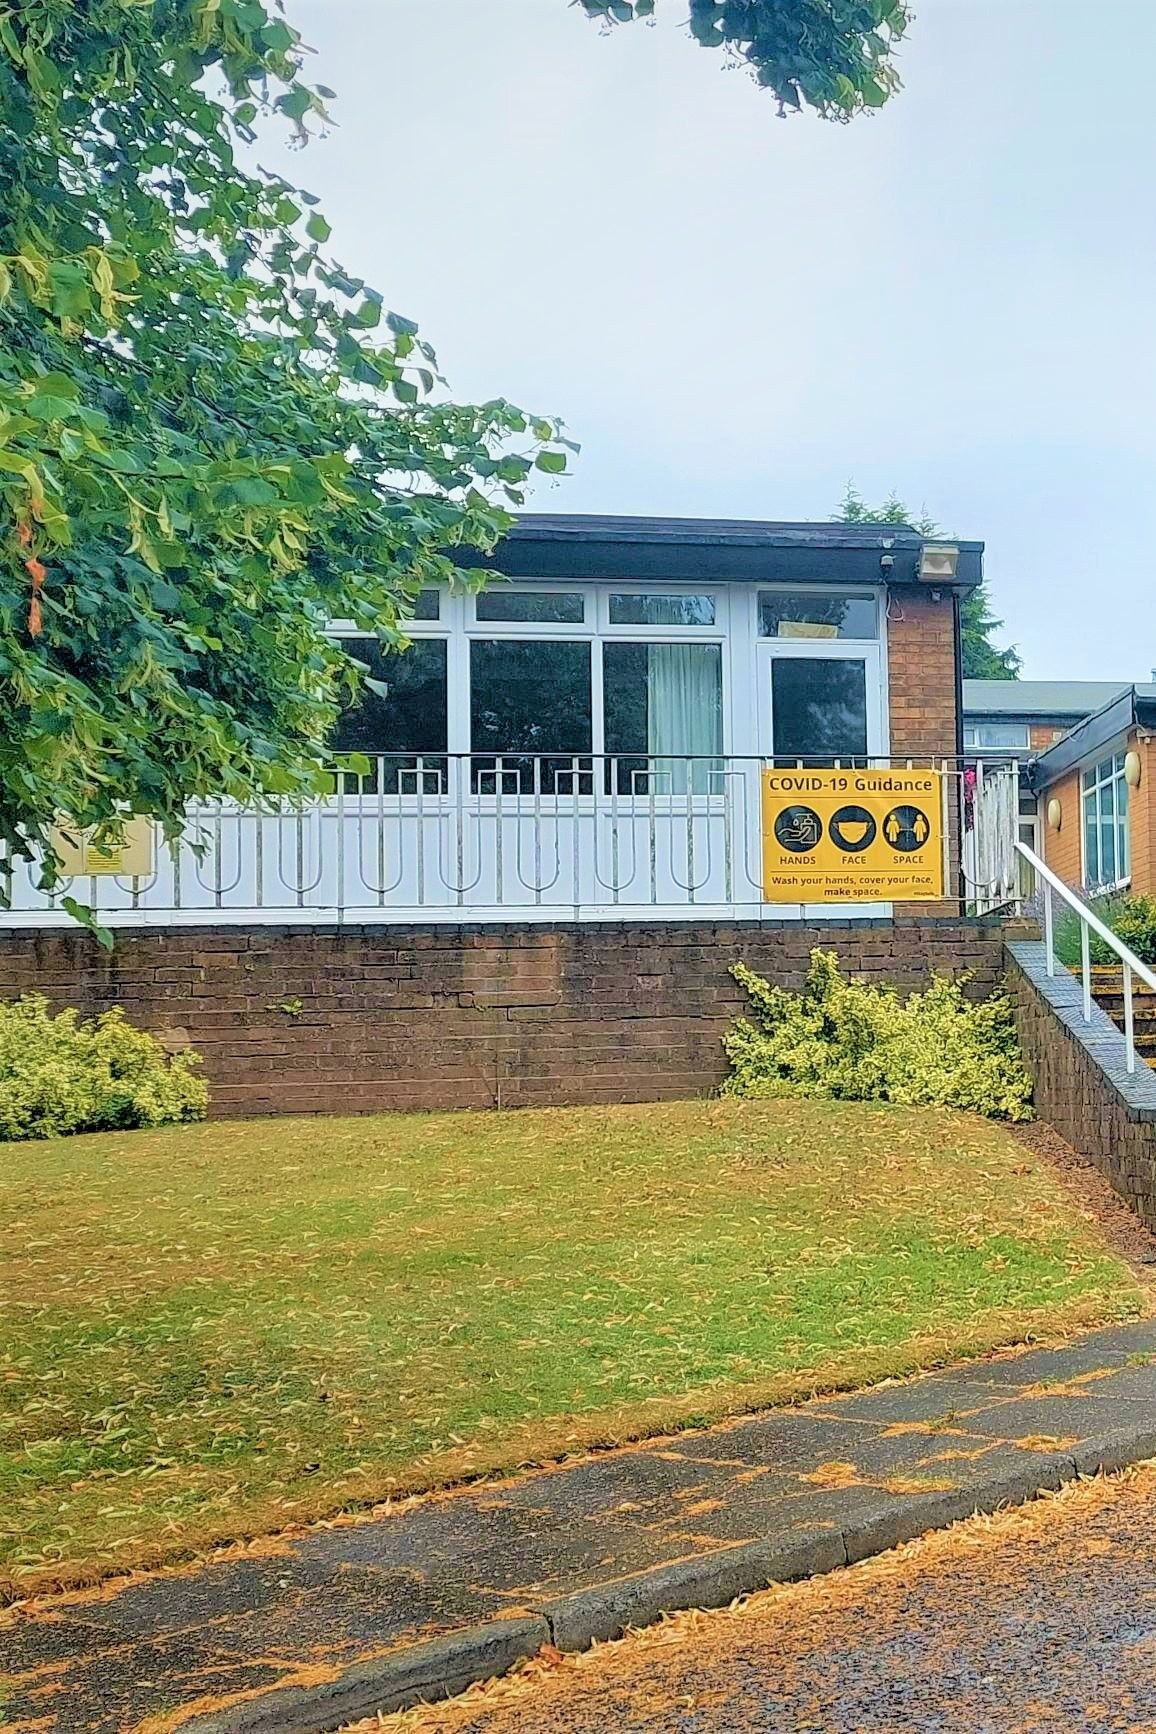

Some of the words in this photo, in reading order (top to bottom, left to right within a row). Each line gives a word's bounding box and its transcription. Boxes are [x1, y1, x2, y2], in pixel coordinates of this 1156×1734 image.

[769, 777, 848, 792] COVID-19
[854, 777, 933, 792] Guidance
[779, 855, 816, 865] HANDS
[842, 855, 867, 865] FACE
[893, 855, 924, 864] SPACE
[772, 876, 798, 885] Wash
[800, 877, 823, 887] your
[825, 875, 857, 886] hands,
[859, 876, 886, 885] cover
[887, 876, 909, 886] your
[824, 887, 850, 897] make
[852, 888, 883, 897] space.
